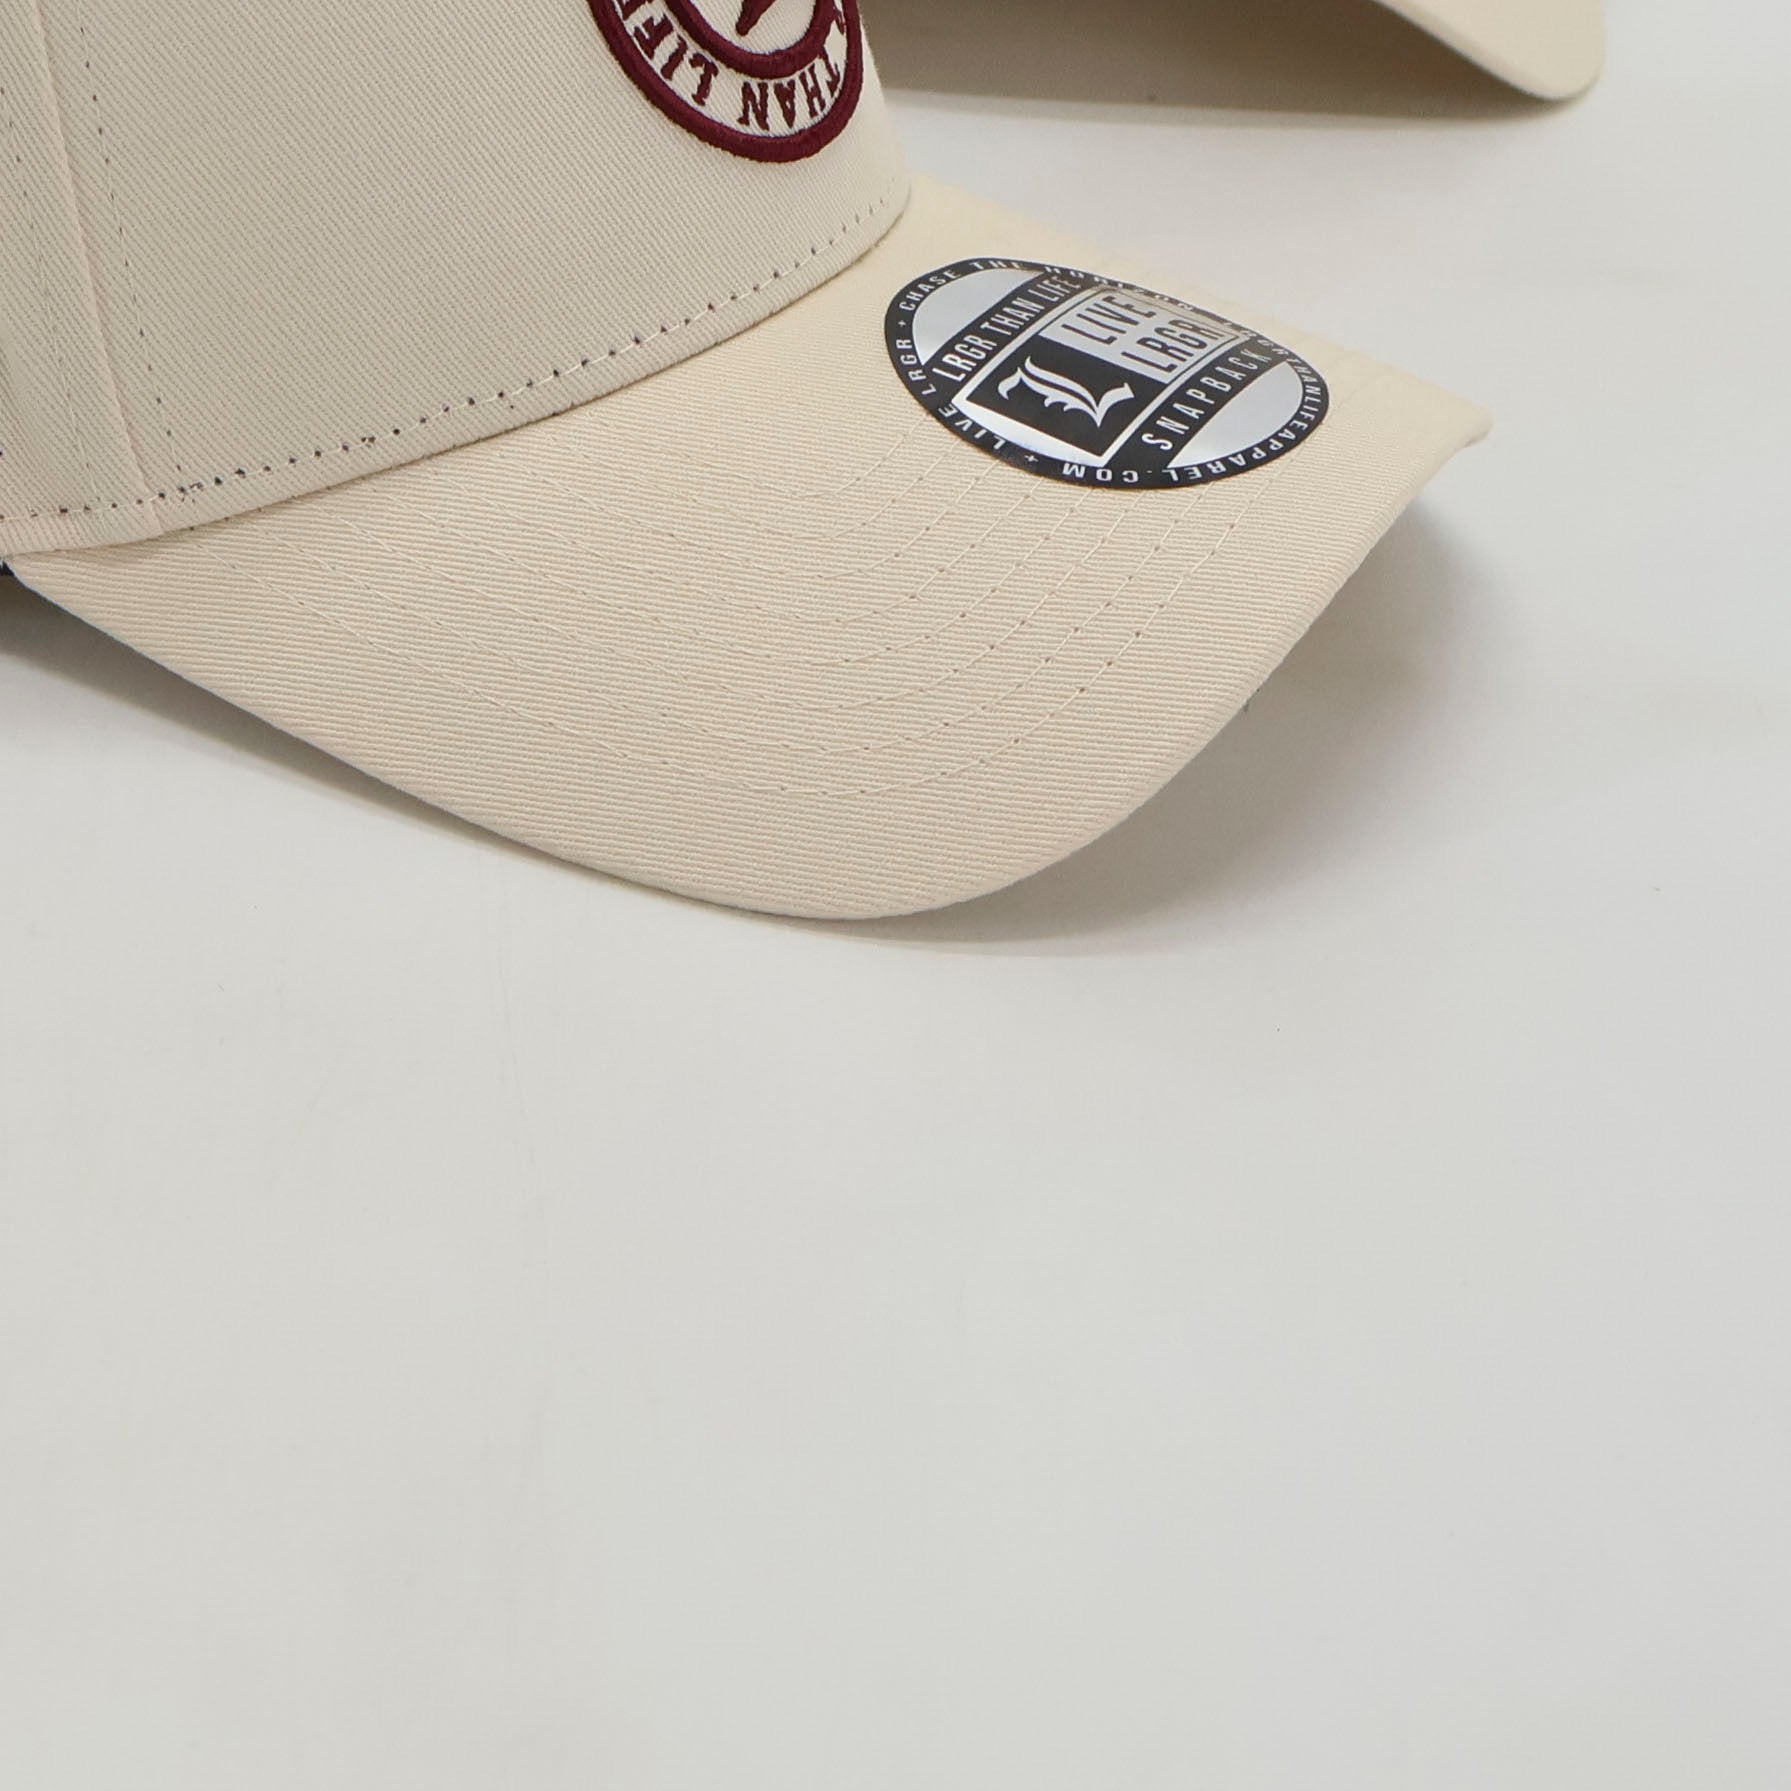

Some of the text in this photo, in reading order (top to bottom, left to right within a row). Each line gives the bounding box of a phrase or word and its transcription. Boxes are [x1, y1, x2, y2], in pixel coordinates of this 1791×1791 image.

[898, 268, 961, 312] CHASE
[931, 275, 1083, 383] LRGR THAN LIFE
[1061, 295, 1157, 346] LIVE
[1121, 319, 1226, 374] LRGR
[896, 338, 1007, 450] LIVE LRGR
[1141, 348, 1273, 451] SNAPBACK
